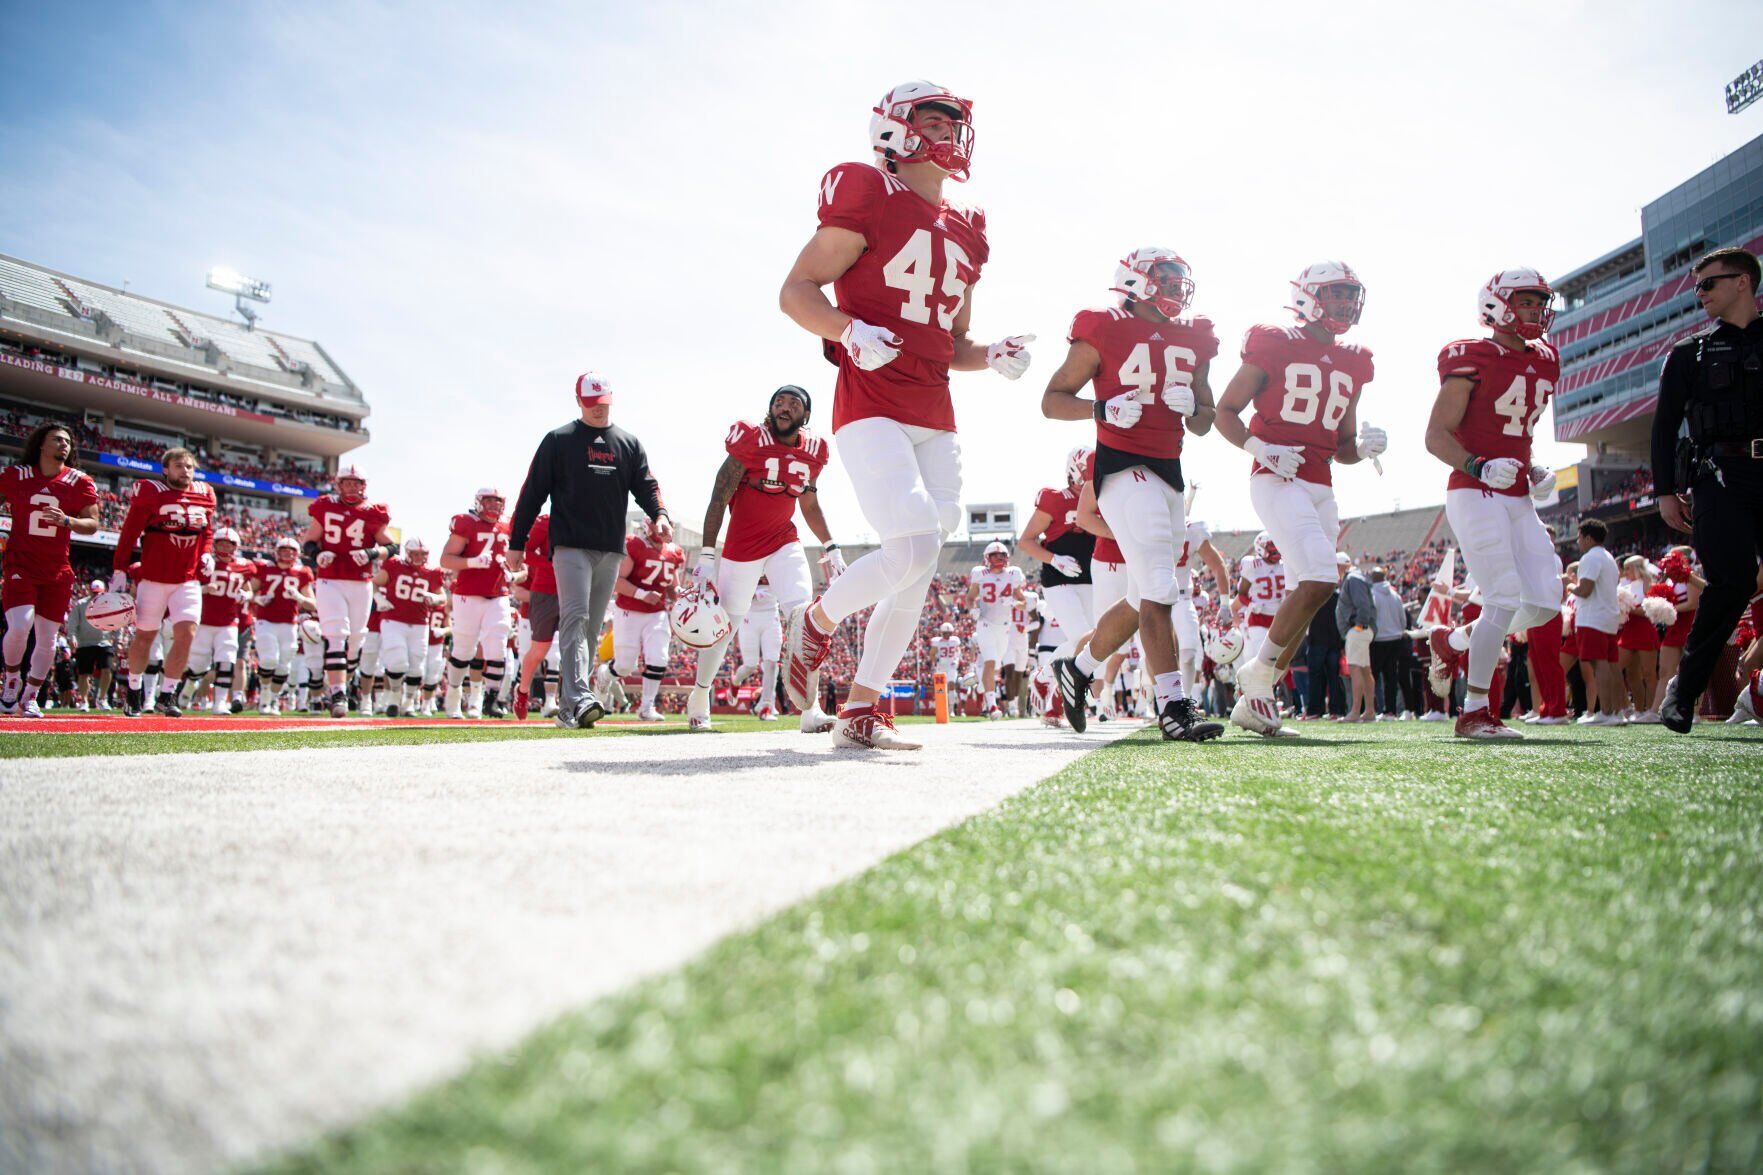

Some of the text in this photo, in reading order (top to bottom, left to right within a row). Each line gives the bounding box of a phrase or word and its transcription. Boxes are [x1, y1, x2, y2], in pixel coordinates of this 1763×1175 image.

[819, 171, 843, 207] N
[883, 229, 973, 331] 45
[0, 353, 53, 374] LEADING
[88, 376, 147, 396] ACADEMIC
[152, 388, 172, 402] ALL
[176, 394, 236, 416] AMERICANS
[1118, 343, 1196, 405] 46
[1280, 363, 1353, 431] 86
[726, 425, 744, 445] N
[765, 458, 811, 493] 13
[1133, 470, 1147, 482] N
[29, 494, 59, 537] 2
[324, 512, 365, 547] 54
[395, 574, 429, 603] 62
[641, 560, 675, 587] 75
[982, 583, 1012, 603] 34
[1424, 596, 1452, 626] N
